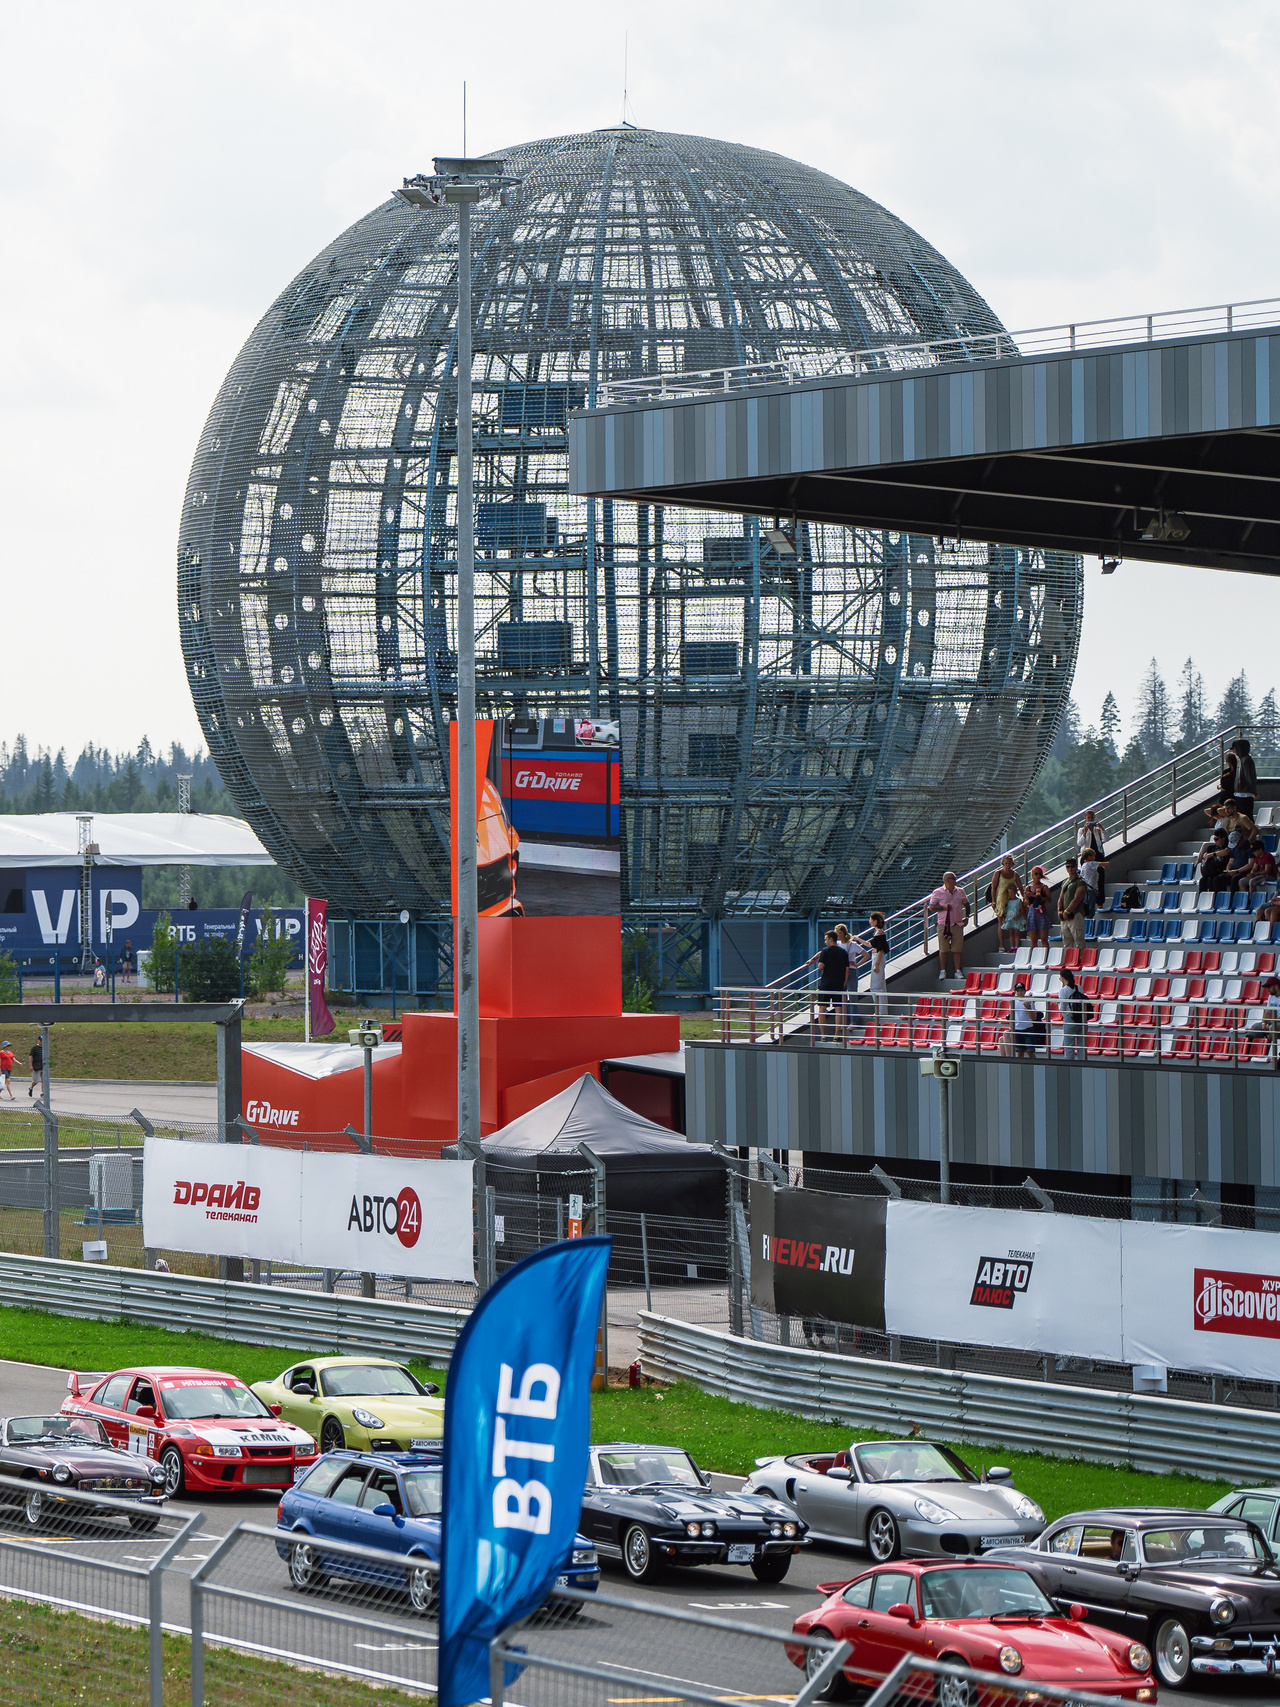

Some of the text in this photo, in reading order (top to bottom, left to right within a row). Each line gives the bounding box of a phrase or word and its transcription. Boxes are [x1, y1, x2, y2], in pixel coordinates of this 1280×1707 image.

[31, 889, 140, 944] VIP
[167, 925, 197, 942] ВТБ
[204, 923, 236, 931] Генеральный
[255, 918, 301, 940] VIP
[173, 1180, 261, 1211] ДРАЙВ
[205, 1210, 258, 1224] ТЕЛЕКАНАЛ
[1007, 1249, 1036, 1260] ТЕЛЕКАНАЛ
[977, 1261, 1029, 1289] АВТО
[973, 1286, 1012, 1305] ПЛЮС
[492, 1362, 561, 1536] ВТБ
